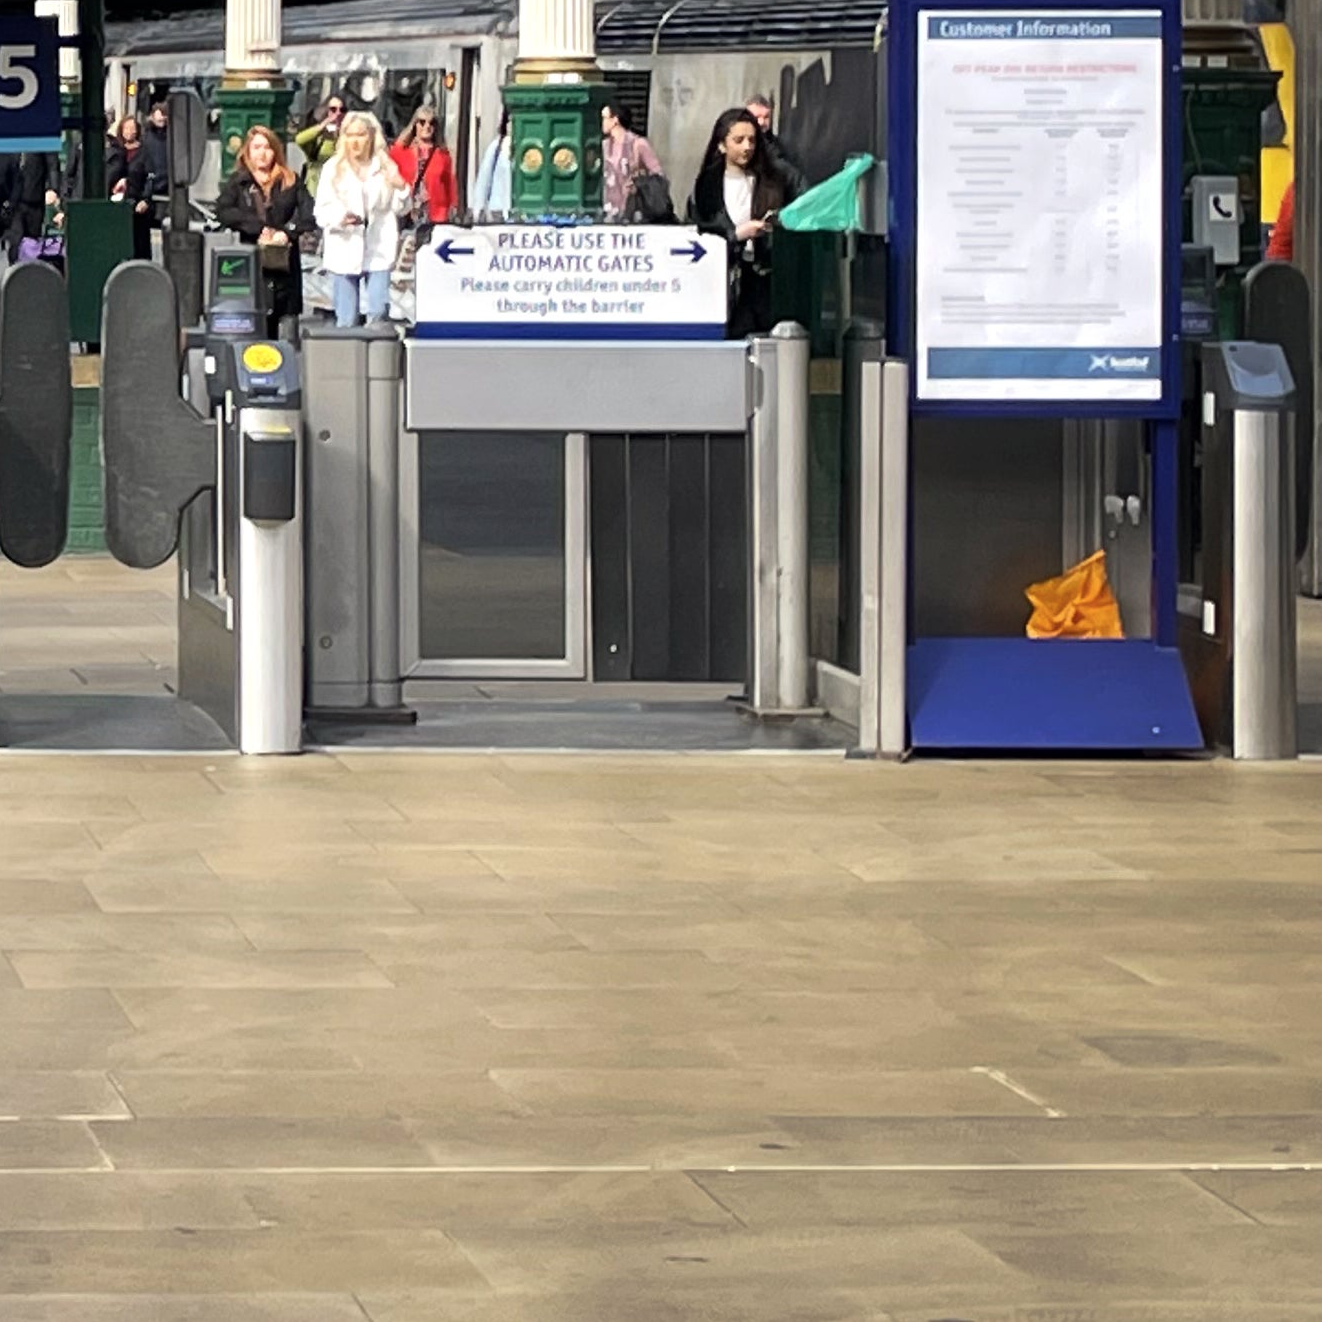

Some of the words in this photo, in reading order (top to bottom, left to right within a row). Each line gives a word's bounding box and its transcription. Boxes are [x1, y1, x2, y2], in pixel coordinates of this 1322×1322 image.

[939, 20, 1012, 38] Customer
[1016, 19, 1112, 37] Information
[497, 230, 565, 250] PLEASE
[570, 232, 606, 250] USE
[610, 232, 645, 250] THE
[487, 253, 593, 273] AUTOMATIC
[597, 254, 654, 273] GATES
[460, 276, 510, 293] Please
[512, 280, 553, 296] carry
[555, 277, 619, 293] children
[621, 277, 668, 293] under
[671, 277, 682, 293] 5
[496, 297, 558, 318] through
[561, 298, 588, 314] the
[590, 298, 645, 314] barrier
